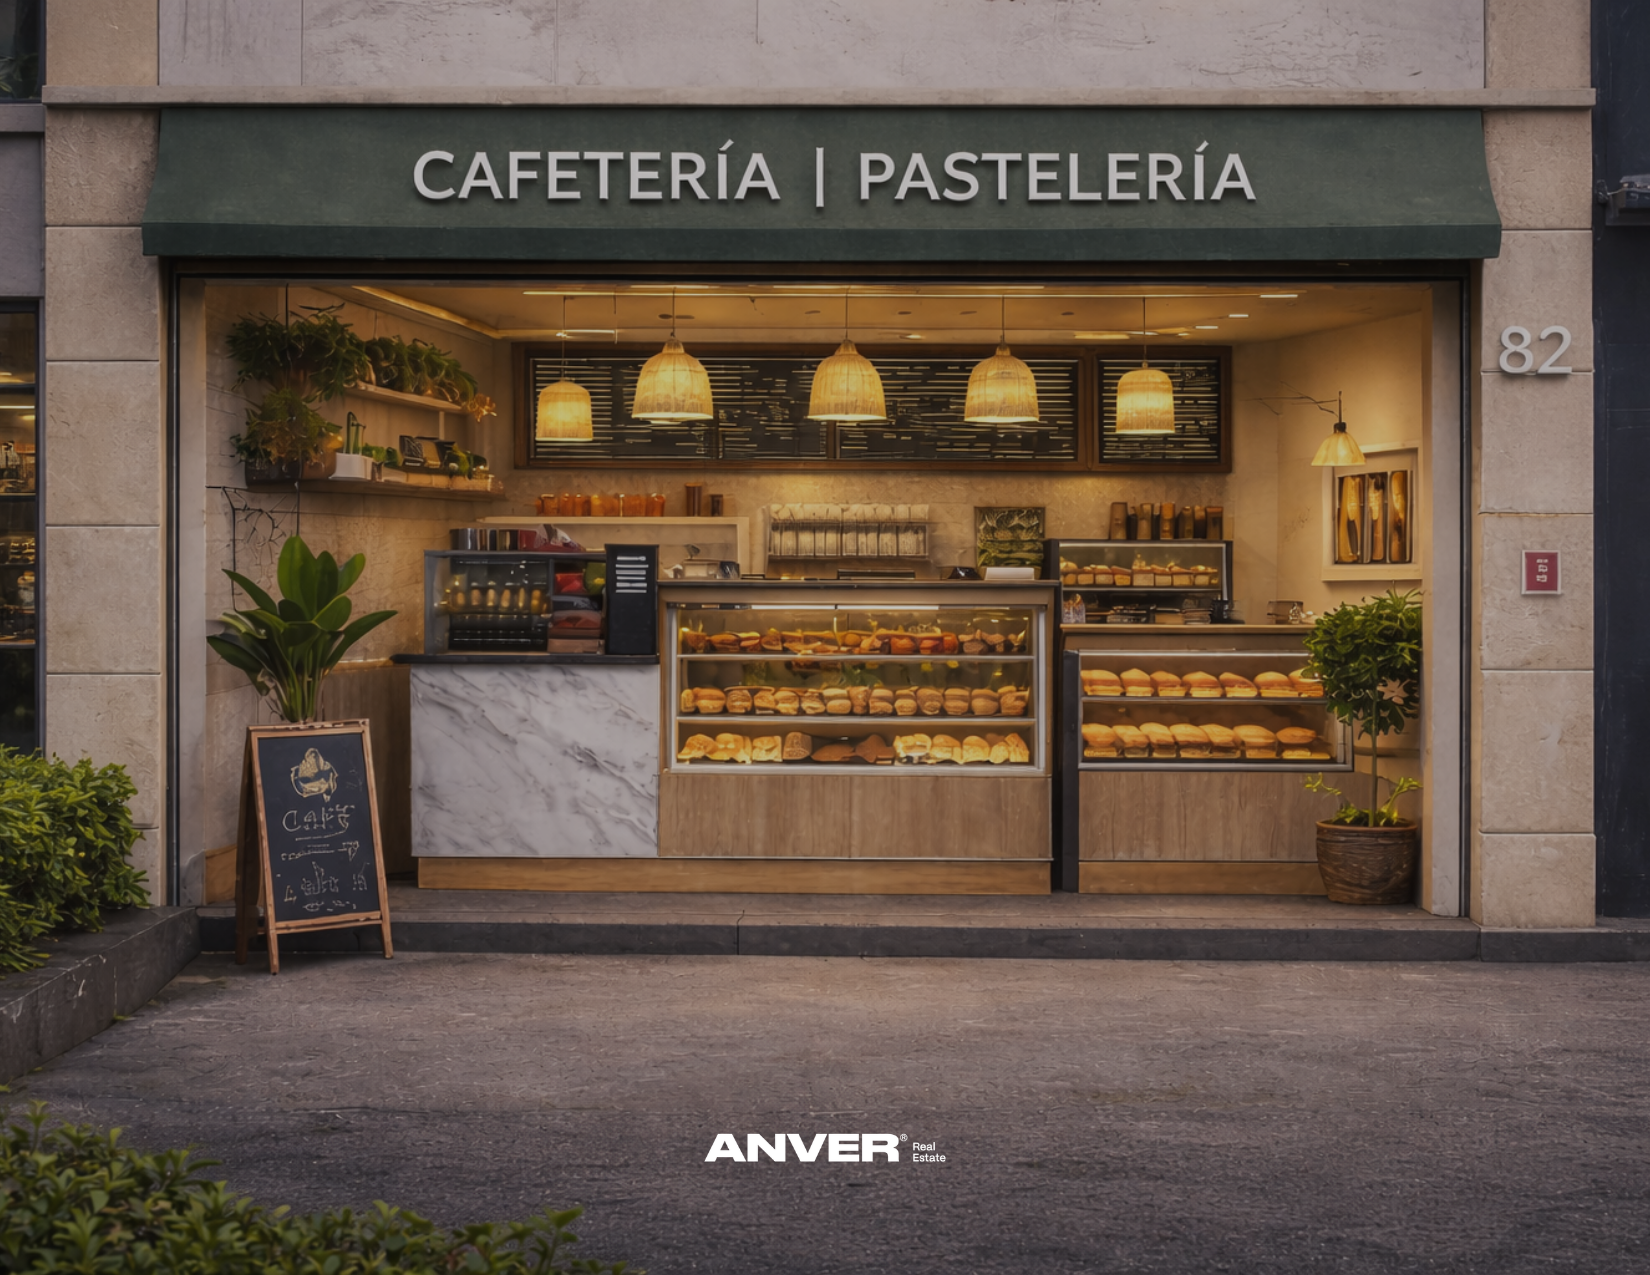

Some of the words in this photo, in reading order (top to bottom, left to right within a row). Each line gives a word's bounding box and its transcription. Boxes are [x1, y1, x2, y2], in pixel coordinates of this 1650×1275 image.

[412, 139, 780, 201] CAFETERÍA
[859, 139, 1256, 201] PASTELERÍA
[1499, 325, 1573, 374] 82
